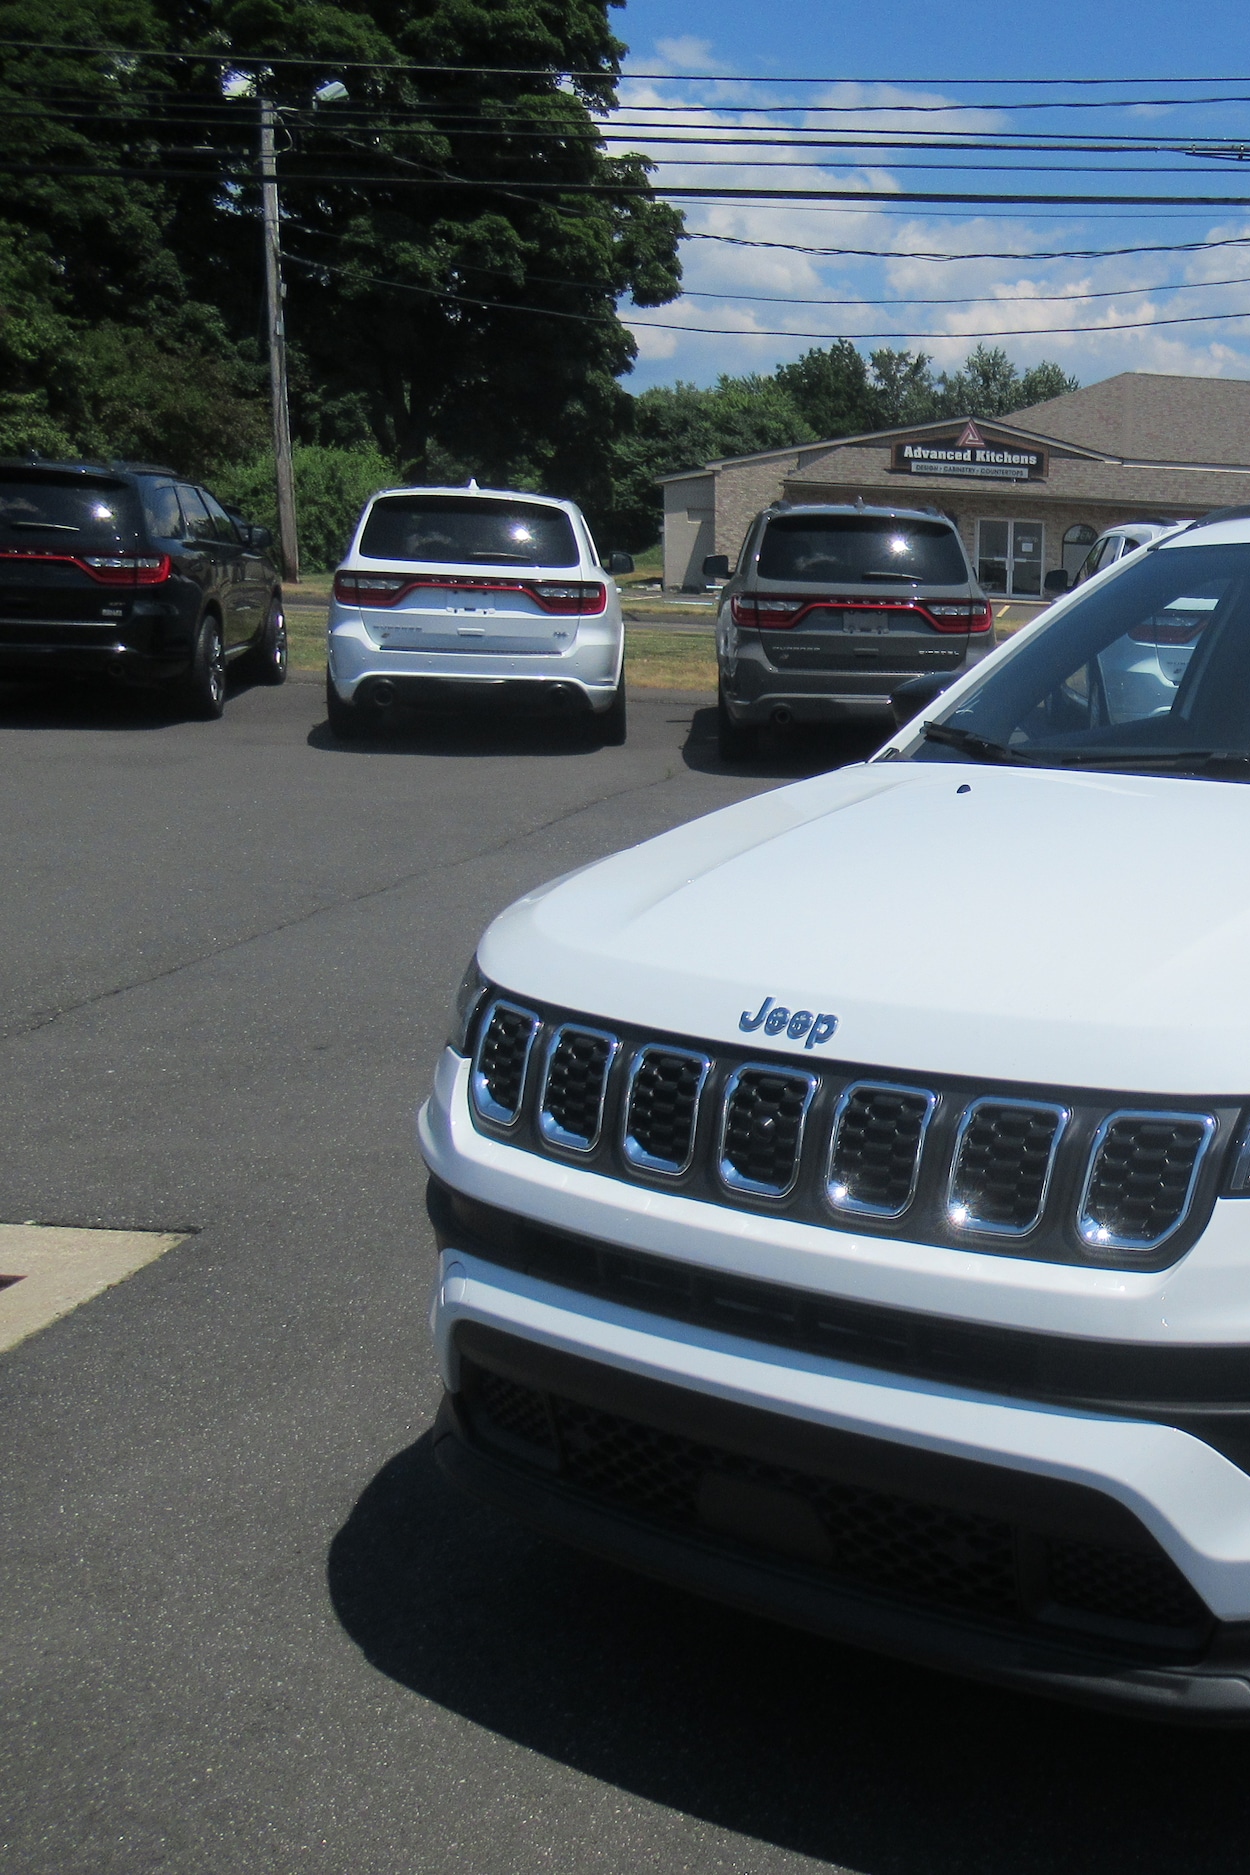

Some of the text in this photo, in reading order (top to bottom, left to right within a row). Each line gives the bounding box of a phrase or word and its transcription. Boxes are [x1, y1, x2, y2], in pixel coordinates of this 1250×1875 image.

[904, 446, 1037, 465] Advanced Kitchens
[943, 465, 976, 473] CABINETRY
[980, 468, 1024, 476] COUNTERTOPS
[739, 996, 839, 1049] Jeep
